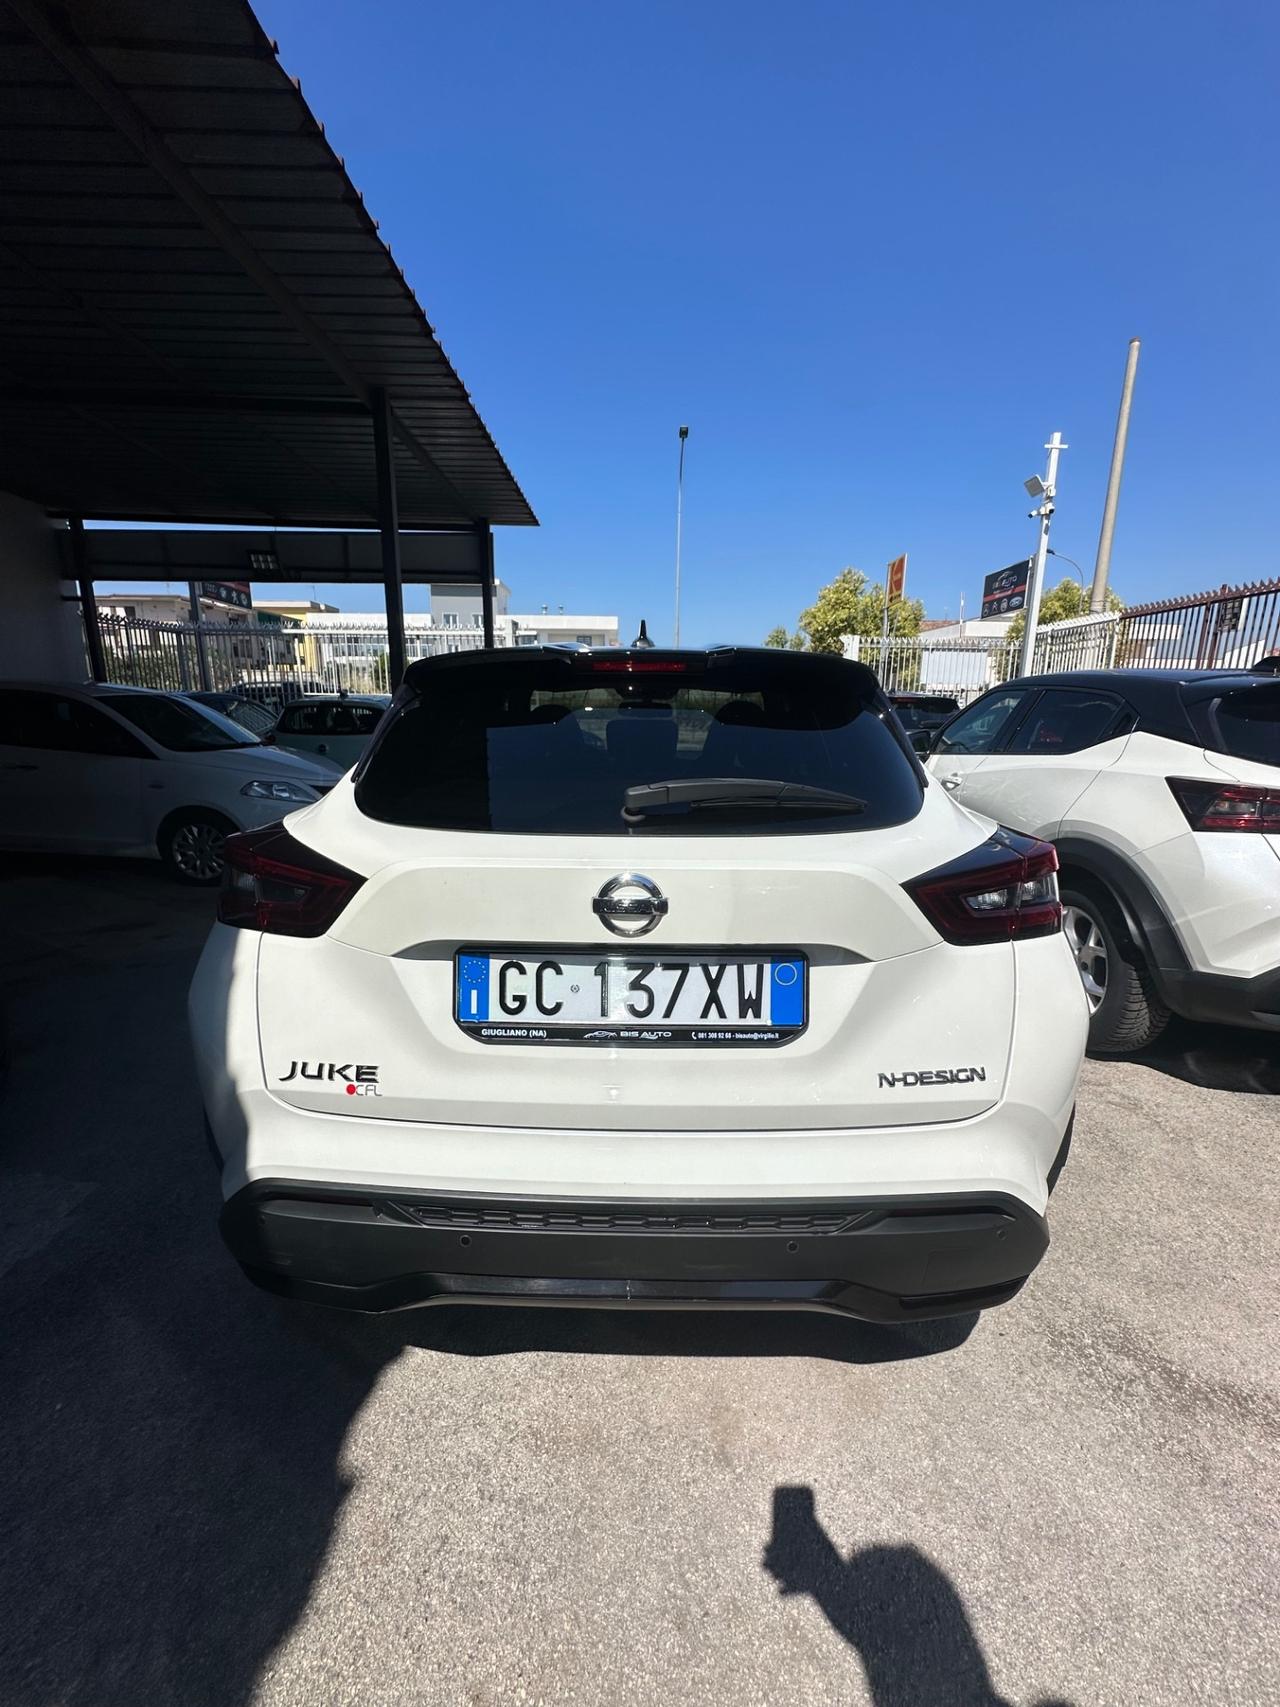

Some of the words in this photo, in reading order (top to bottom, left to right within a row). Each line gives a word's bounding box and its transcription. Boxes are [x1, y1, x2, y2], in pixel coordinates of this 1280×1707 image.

[499, 960, 563, 1016] GC
[481, 1028, 528, 1037] GIUGLIANO
[529, 1029, 547, 1038] (NA)
[639, 1031, 672, 1039] AUTO
[278, 1060, 380, 1084] JUKE
[877, 1066, 987, 1089] N-DESIGN
[355, 1084, 383, 1097] CFL
